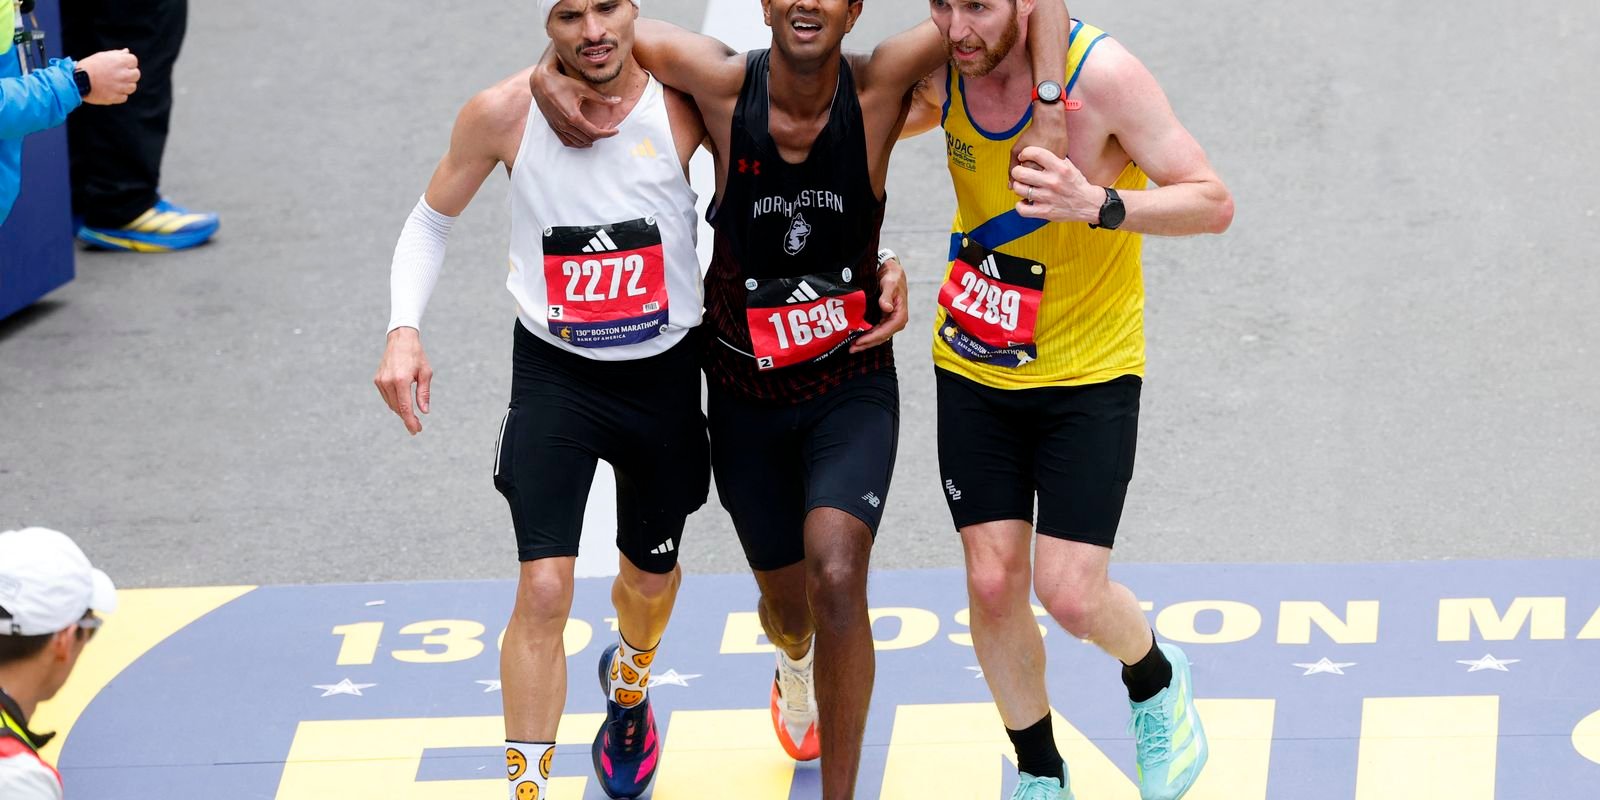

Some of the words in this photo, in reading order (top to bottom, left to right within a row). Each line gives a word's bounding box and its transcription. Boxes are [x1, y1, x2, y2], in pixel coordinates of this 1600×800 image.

[561, 254, 648, 302] 2272
[951, 271, 1021, 331] 2289
[551, 307, 560, 317] 3
[591, 326, 620, 336] BOSTON
[620, 319, 659, 332] MARATHON
[768, 297, 849, 350] 1636
[601, 333, 626, 341] AMERICA
[760, 358, 771, 368] 2
